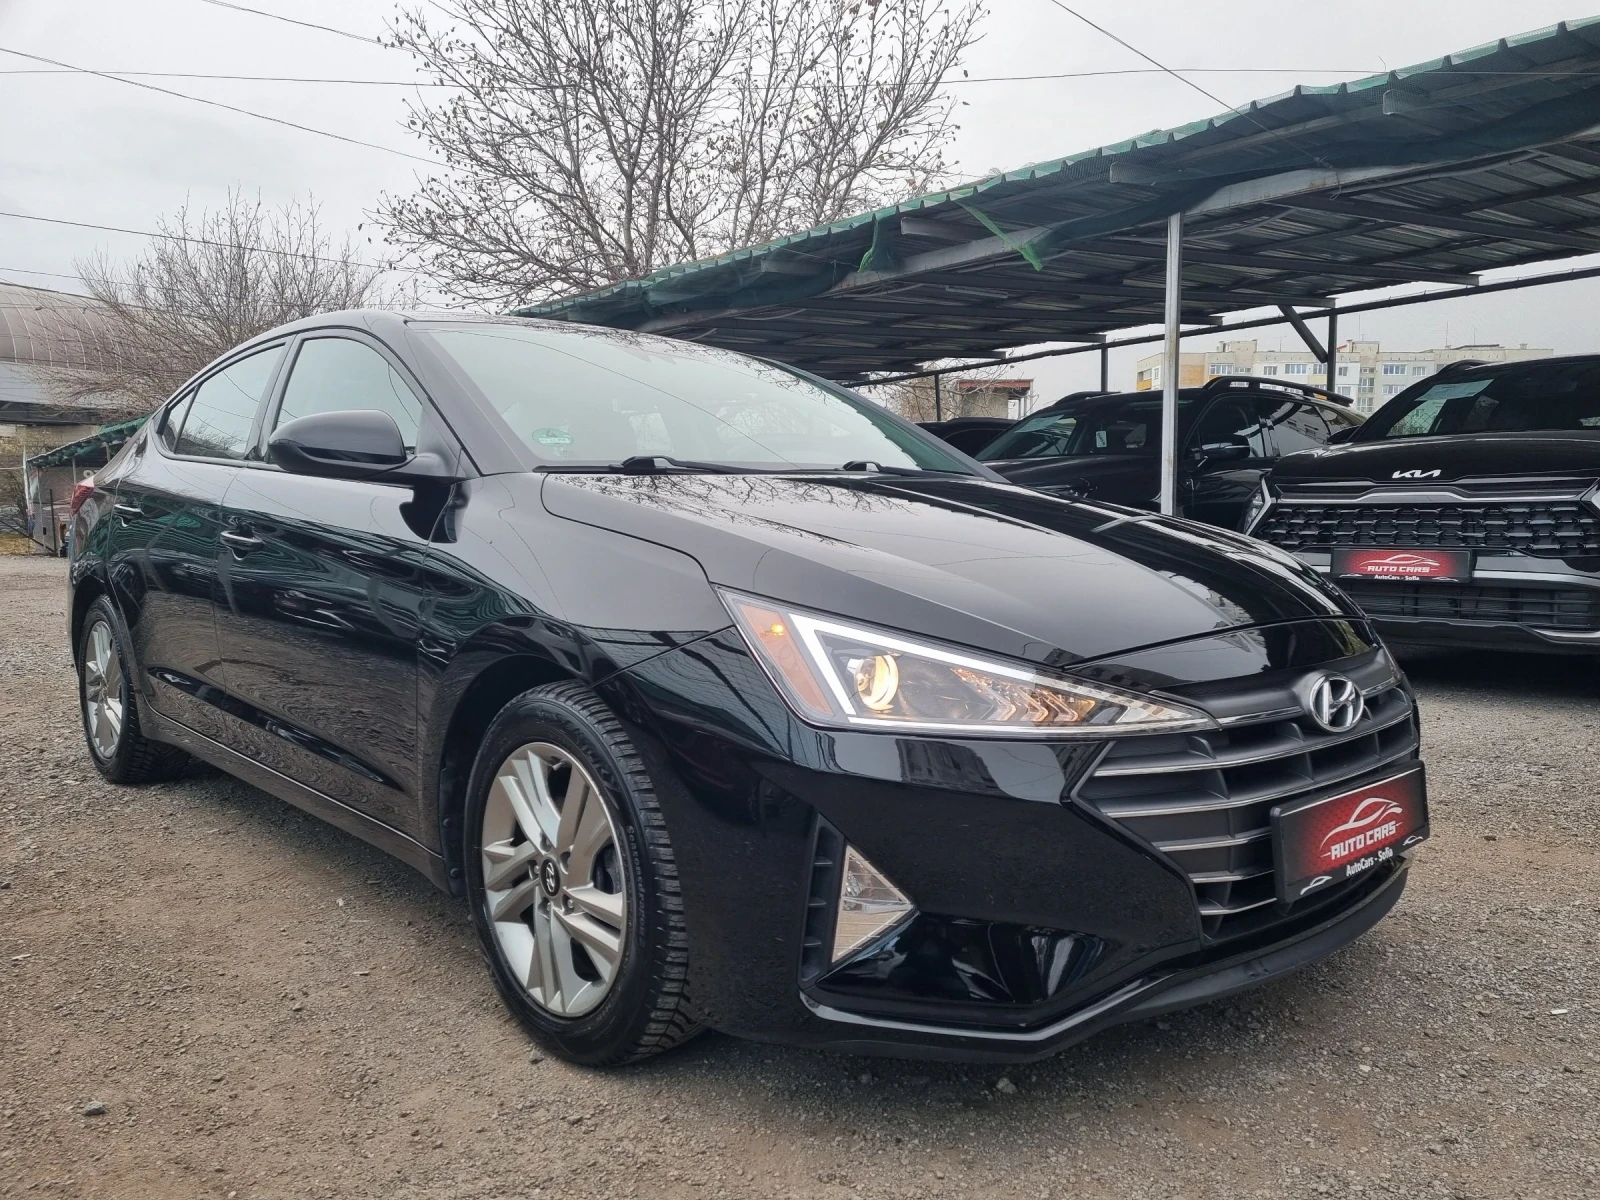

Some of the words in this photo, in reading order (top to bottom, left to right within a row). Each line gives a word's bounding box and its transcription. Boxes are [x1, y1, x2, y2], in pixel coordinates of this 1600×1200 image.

[1331, 832, 1365, 860] AUTO
[1365, 820, 1396, 846] CARS
[1346, 857, 1374, 877] AutoCars
[1378, 846, 1393, 861] Sofia
